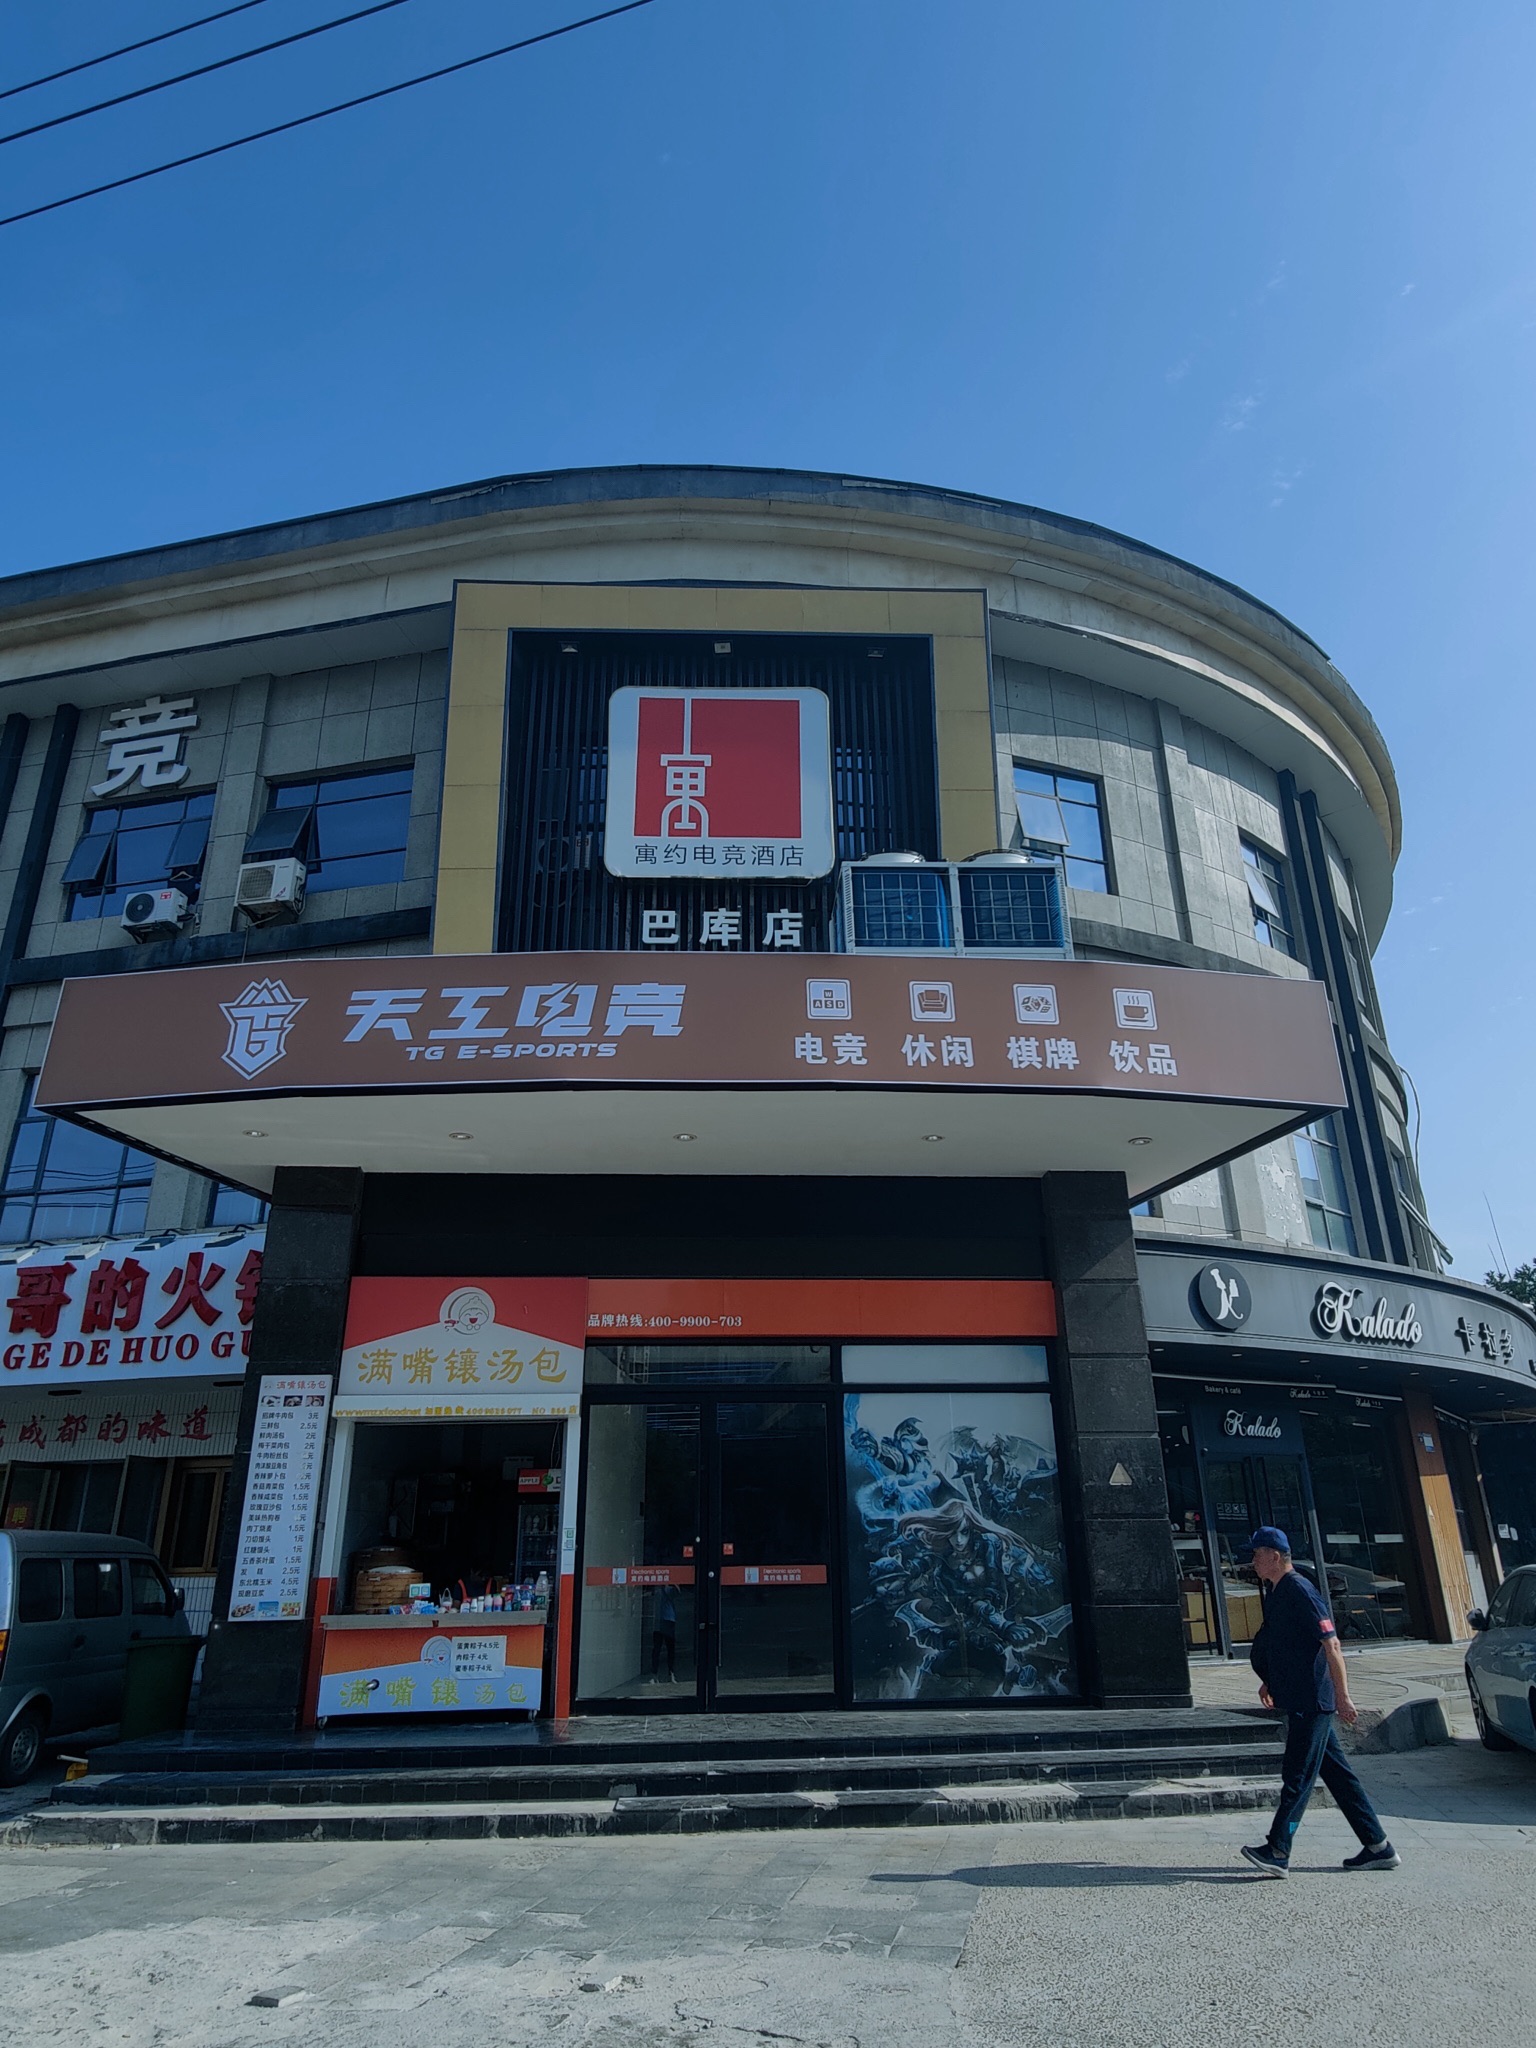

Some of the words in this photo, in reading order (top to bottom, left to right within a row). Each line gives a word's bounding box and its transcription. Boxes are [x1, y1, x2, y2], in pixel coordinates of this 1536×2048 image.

[90, 695, 198, 797] 竞
[634, 843, 805, 867] 寓约电竞酒店
[641, 907, 804, 948] 巴库店
[342, 981, 687, 1043] 天工电竞
[405, 1045, 446, 1061] TG
[456, 1042, 618, 1060] E-SPORTS
[794, 1032, 868, 1066] 电竞
[901, 1033, 975, 1068] 休闲
[1006, 1035, 1081, 1071] 棋牌
[1108, 1039, 1179, 1077] 饮品
[1317, 1281, 1423, 1344] Kalado
[3, 1342, 52, 1370] GE
[60, 1339, 111, 1367] DE
[119, 1332, 200, 1364] HUO
[1456, 1317, 1516, 1362] 卡拉多
[0, 1405, 212, 1449] 成都的味道
[300, 1422, 318, 1430] 2.5元
[306, 1432, 317, 1440] 2元
[1224, 1409, 1282, 1439] Kalado
[304, 1442, 315, 1450] 2元
[291, 1503, 308, 1511] 1.5元
[288, 1524, 305, 1532] 1.5元
[242, 1557, 276, 1565] 五香茶叶蛋
[284, 1556, 302, 1564] 1.5元
[282, 1567, 300, 1575] 2.5元
